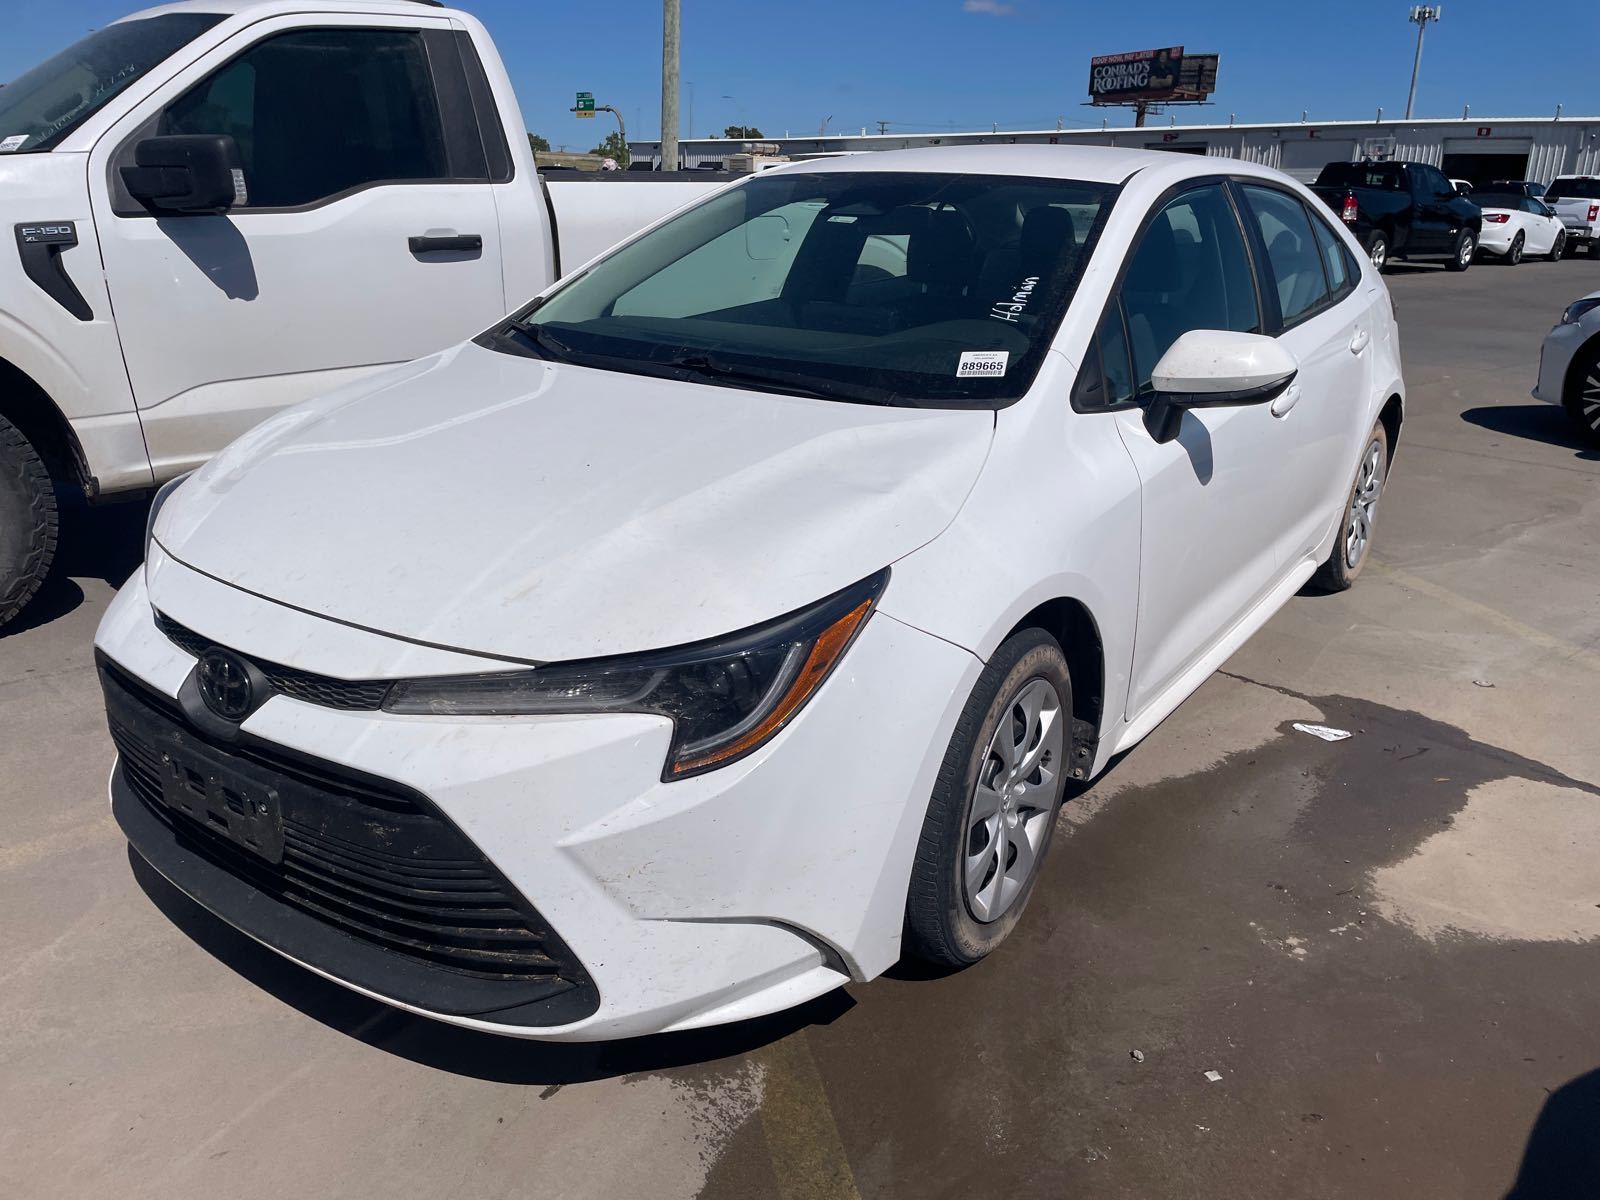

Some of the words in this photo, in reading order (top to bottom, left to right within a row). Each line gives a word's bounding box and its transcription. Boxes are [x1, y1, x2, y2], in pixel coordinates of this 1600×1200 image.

[1094, 61, 1150, 78] CONRAD'S
[1093, 73, 1148, 93] ROOFING
[22, 226, 72, 236] F-150
[961, 361, 1004, 371] 889665
